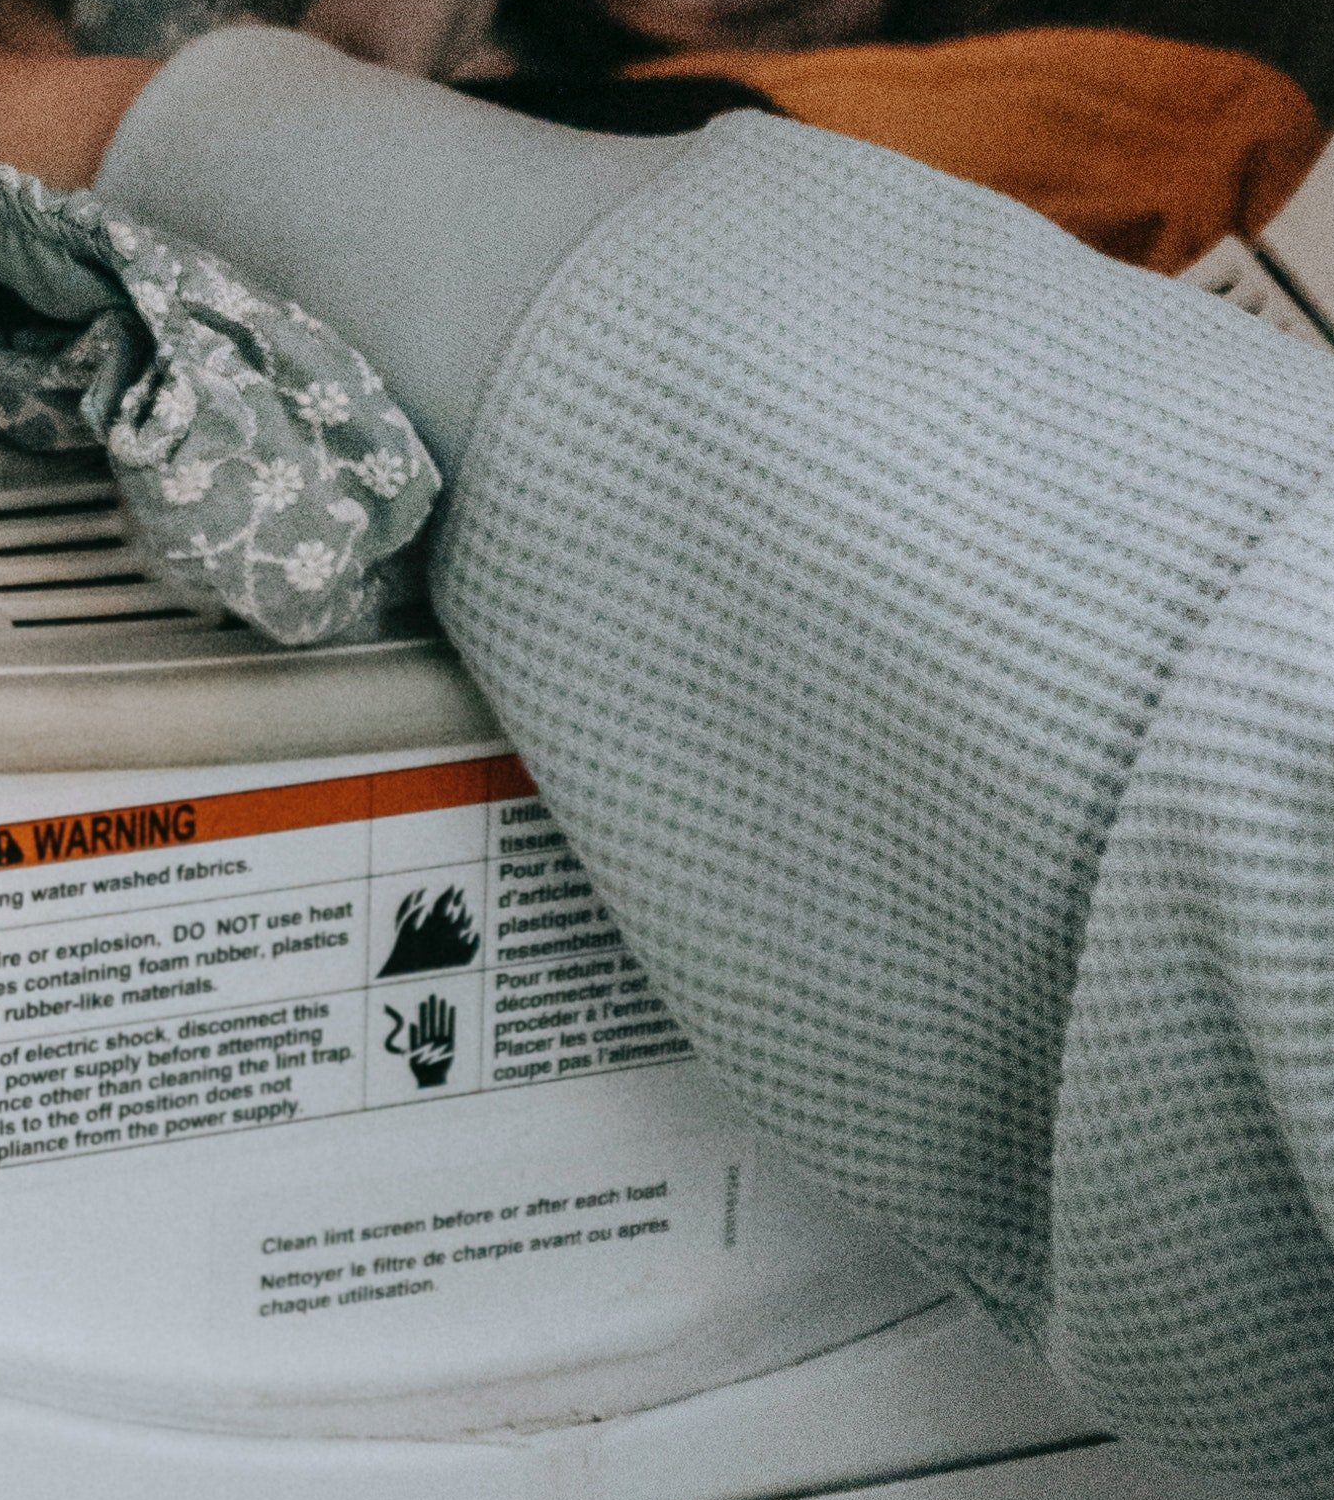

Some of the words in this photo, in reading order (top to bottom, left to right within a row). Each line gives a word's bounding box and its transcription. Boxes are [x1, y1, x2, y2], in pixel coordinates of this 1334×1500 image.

[32, 804, 196, 860] WARNING
[31, 882, 86, 901] water
[92, 867, 170, 893] washed
[176, 860, 252, 881] fabrics.
[499, 862, 547, 881] Pour
[498, 881, 593, 909] d'articles
[27, 948, 49, 965] or
[173, 922, 205, 943] DO
[216, 914, 260, 935] NOT
[266, 913, 302, 929] use
[309, 902, 353, 922] heat
[497, 908, 593, 942] plastique
[24, 964, 131, 992] containing
[138, 955, 189, 974] foam
[272, 932, 349, 958] plastics
[495, 972, 543, 991] Pour
[4, 994, 114, 1021] rubber-like
[121, 978, 218, 1003] materials.
[0, 1046, 20, 1067] of
[24, 1039, 98, 1063] electric
[178, 1009, 287, 1039] disconnect
[294, 1005, 329, 1022] this
[494, 1037, 555, 1060] Placer
[560, 1032, 587, 1048] les
[5, 1068, 67, 1092] power
[74, 1054, 140, 1079] supply
[147, 1045, 211, 1067] before
[217, 1028, 322, 1056] attempting
[39, 1086, 91, 1107] other
[98, 1079, 142, 1097] than
[148, 1065, 232, 1090] cleaning
[238, 1059, 269, 1076] the
[275, 1051, 306, 1069] lint
[311, 1046, 354, 1064] trap.
[493, 1060, 552, 1082] coupe
[559, 1054, 592, 1075] pas
[21, 1116, 42, 1133] to
[47, 1111, 80, 1128] the
[85, 1102, 113, 1122] off
[118, 1093, 199, 1121] position
[205, 1085, 254, 1104] does
[260, 1076, 292, 1094] not
[74, 1128, 121, 1146] from
[127, 1122, 159, 1140] the
[164, 1112, 226, 1136] power
[261, 1235, 317, 1255] Clean
[324, 1228, 354, 1245] lint
[360, 1220, 425, 1240] screen
[432, 1210, 494, 1231] before
[500, 1206, 519, 1220] or
[525, 1198, 569, 1217] after
[574, 1189, 620, 1209] each
[260, 1267, 343, 1289] Nettoyer
[350, 1263, 366, 1278] le
[372, 1257, 417, 1273] filtre
[422, 1251, 446, 1267] de
[452, 1241, 524, 1263] charpie
[530, 1230, 582, 1251] avant
[587, 1228, 612, 1243] ou
[259, 1295, 331, 1317] chaque
